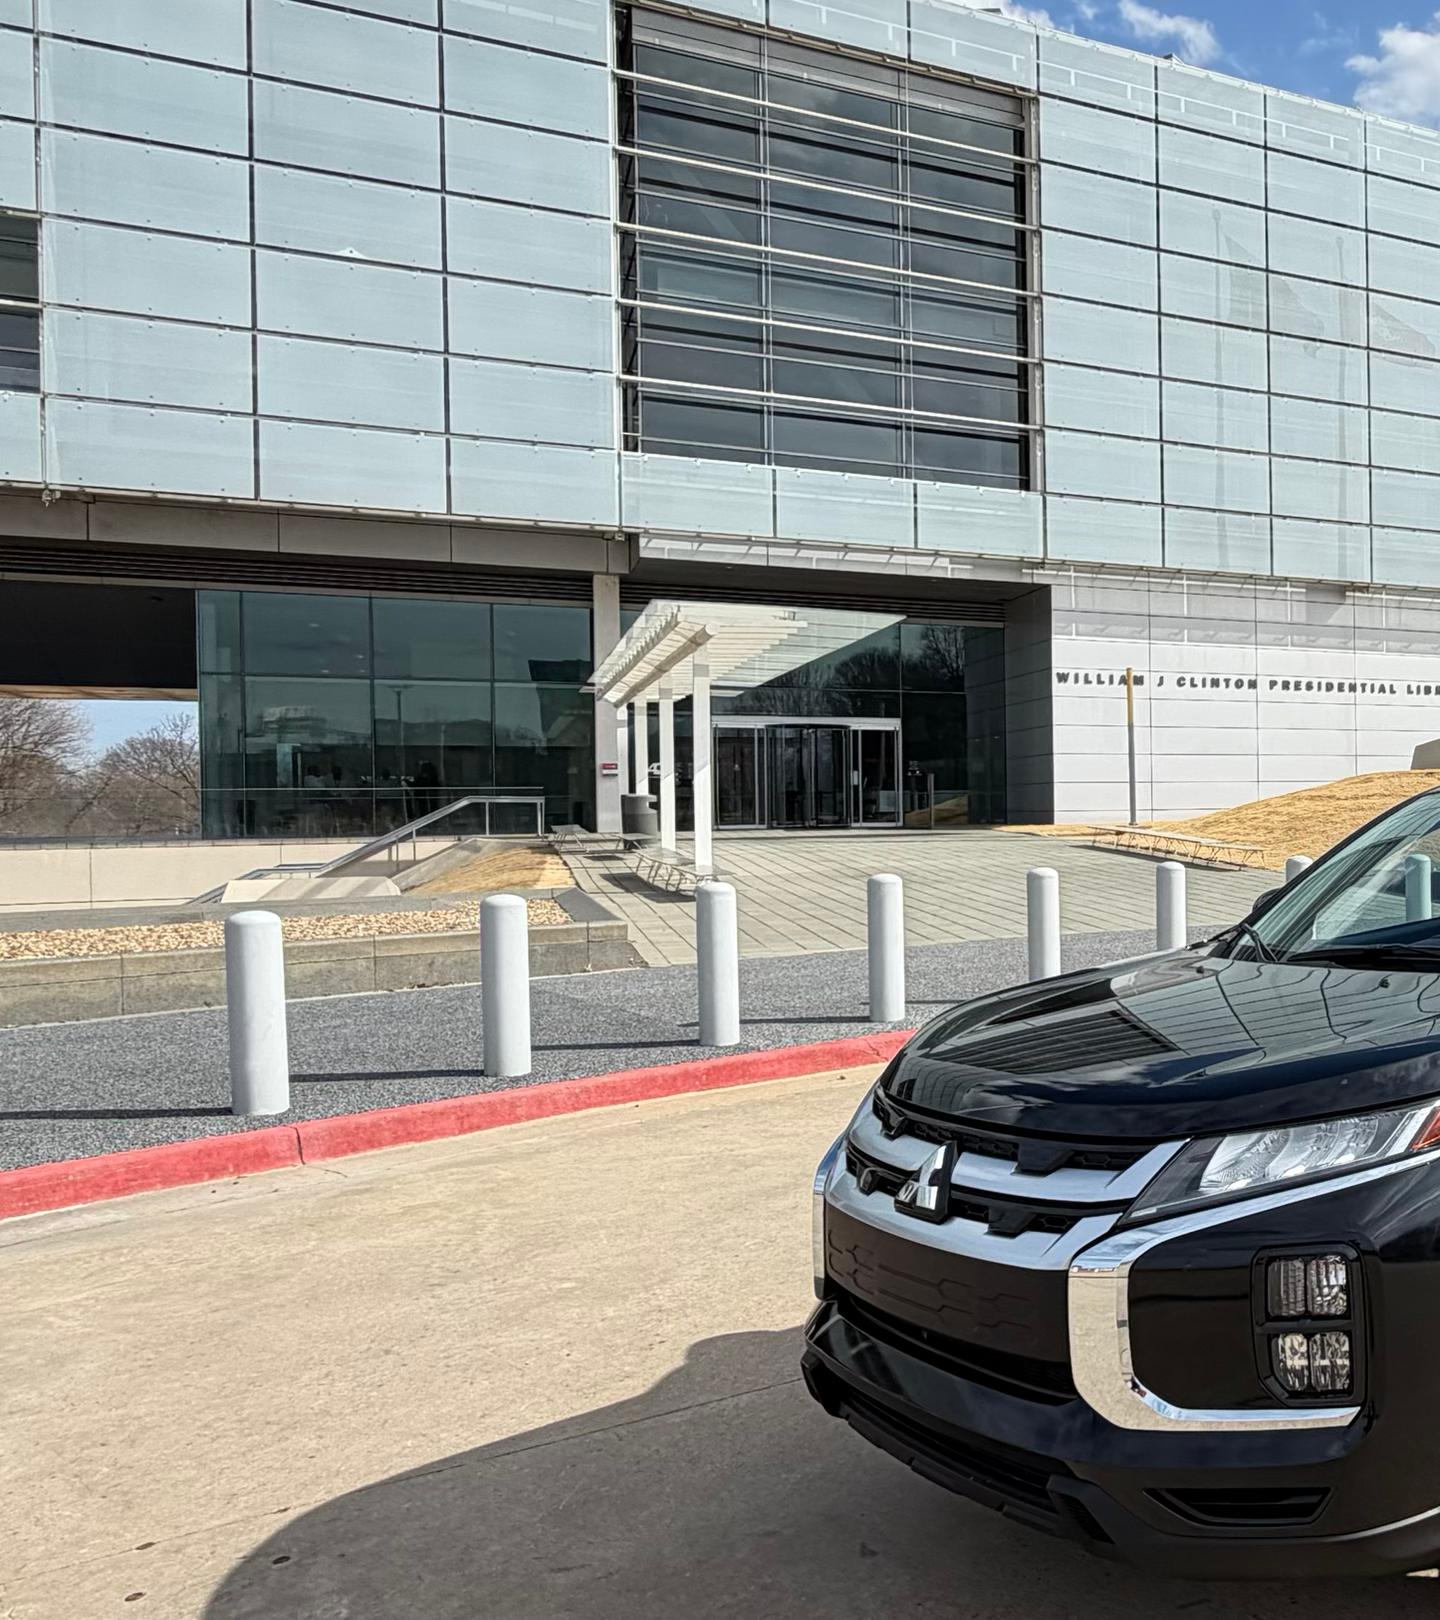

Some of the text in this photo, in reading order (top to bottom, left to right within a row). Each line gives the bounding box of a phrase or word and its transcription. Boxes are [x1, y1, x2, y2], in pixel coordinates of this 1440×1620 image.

[1157, 676, 1164, 687] J
[1176, 676, 1257, 689] CLINTON
[1269, 680, 1396, 694] PRESIDENTIAL
